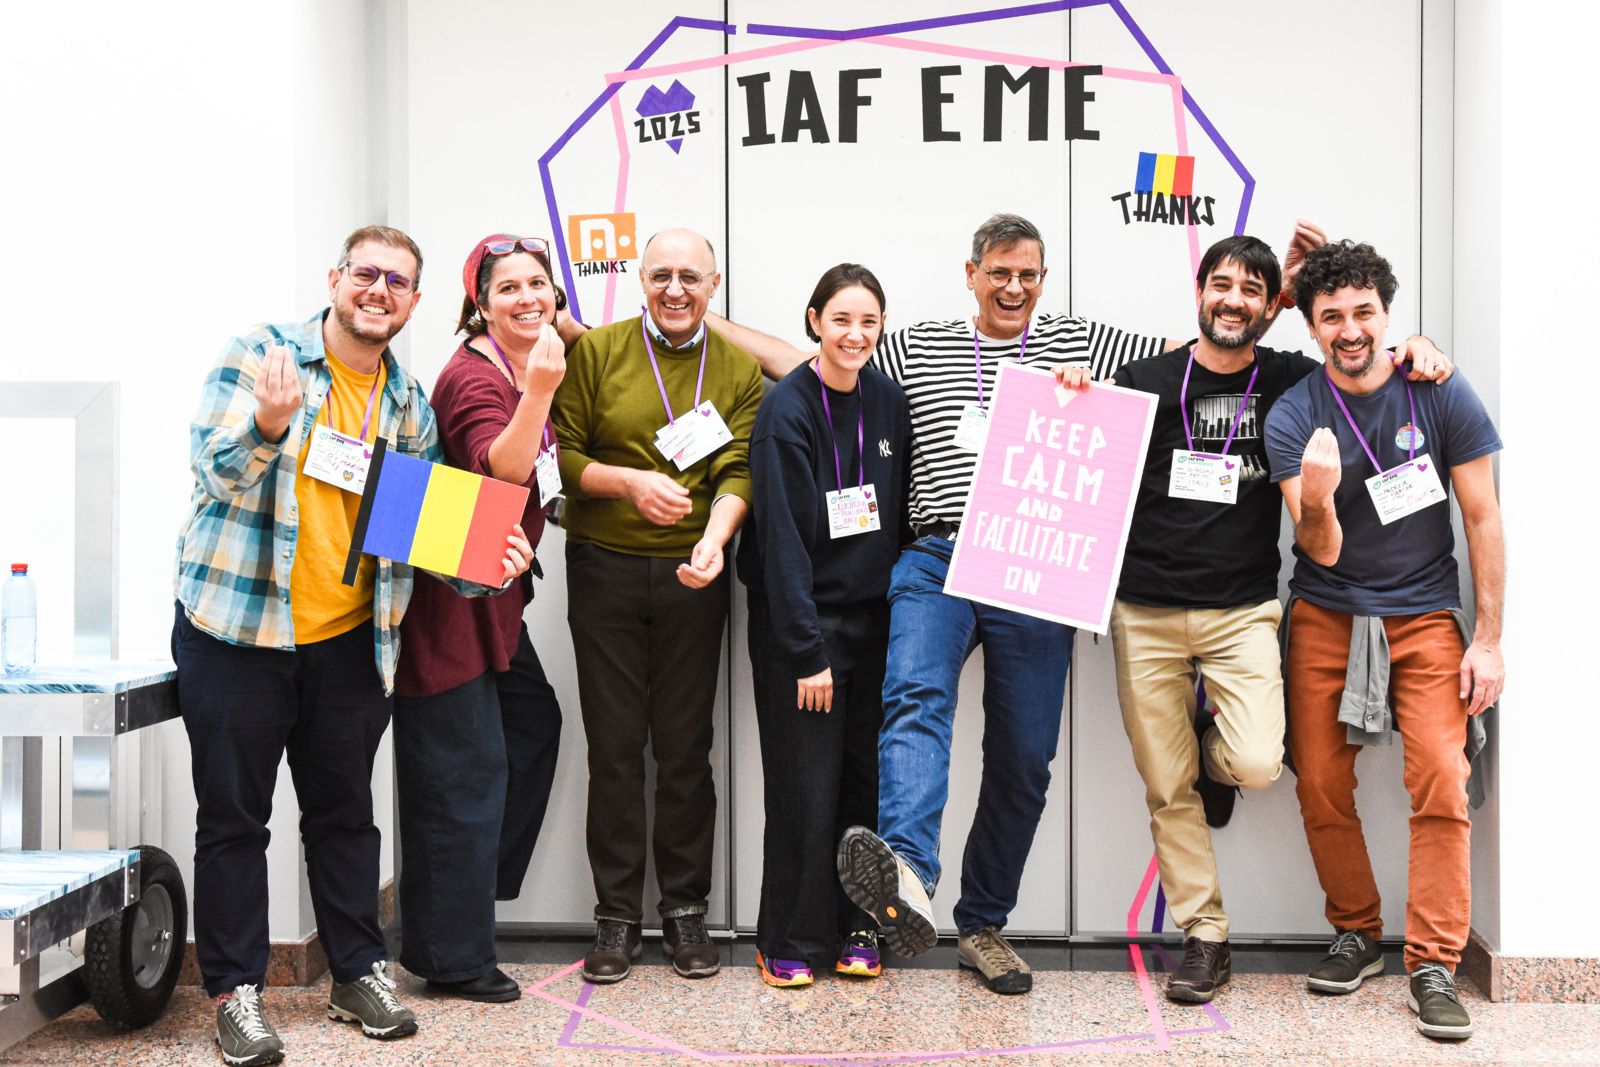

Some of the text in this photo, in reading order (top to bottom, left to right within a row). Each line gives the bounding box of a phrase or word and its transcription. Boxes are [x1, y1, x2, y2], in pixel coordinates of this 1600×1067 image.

[736, 64, 1103, 147] IAF EME
[634, 110, 701, 143] 2025
[1111, 190, 1216, 227] THANKS
[574, 260, 627, 277] THANKS
[1024, 408, 1108, 459] KEEP
[1001, 445, 1105, 506] CALM
[1016, 496, 1063, 522] AND
[972, 511, 1098, 572] FACILITATE
[1004, 566, 1042, 596] ON
